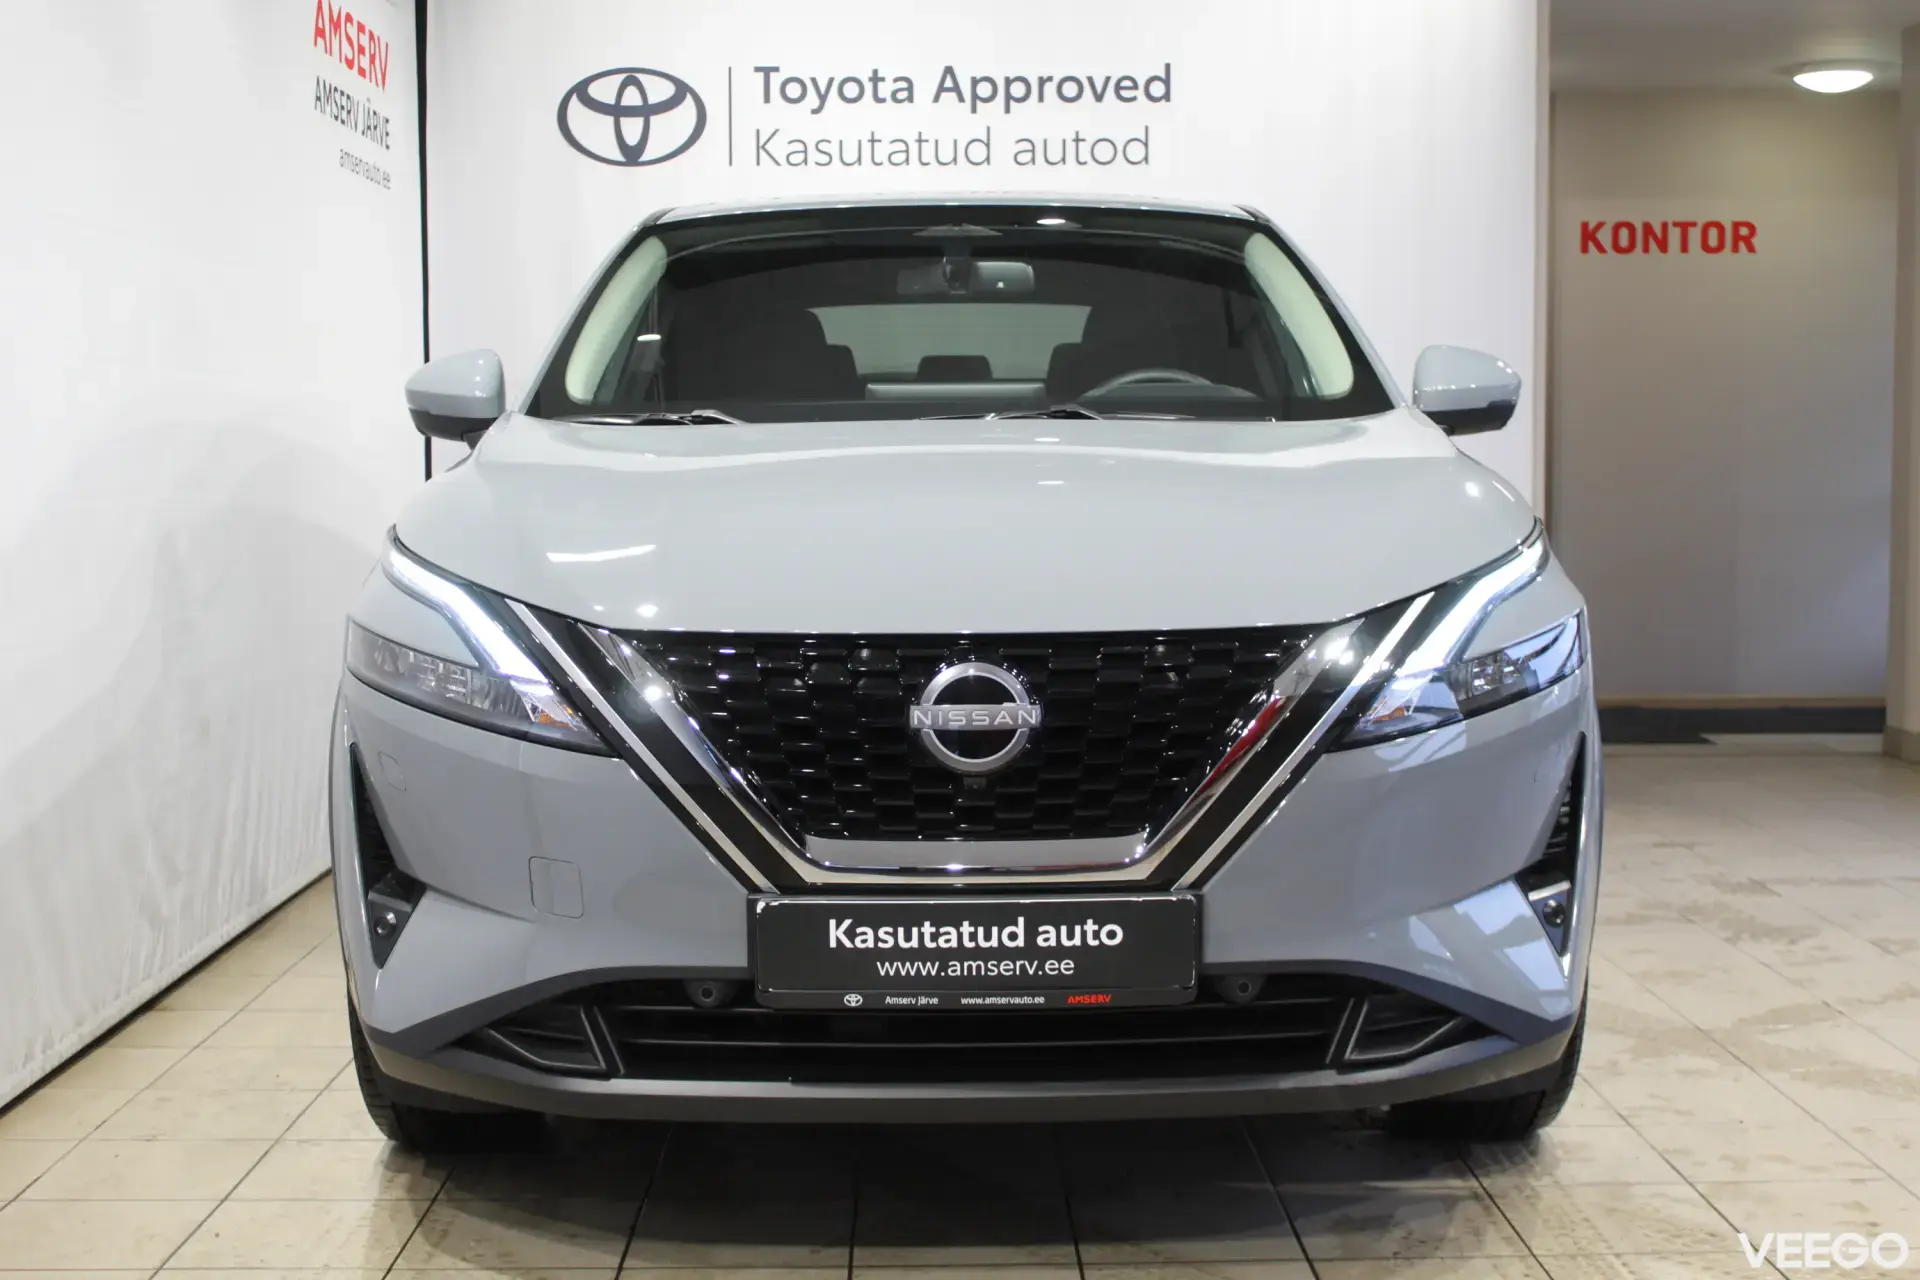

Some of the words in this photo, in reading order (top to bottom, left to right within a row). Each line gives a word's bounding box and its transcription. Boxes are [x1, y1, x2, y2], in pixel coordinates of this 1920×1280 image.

[313, 0, 389, 92] AMSERV
[754, 65, 915, 114] Toyota
[932, 63, 1172, 114] Approved
[314, 75, 359, 133] AMSERV
[361, 96, 390, 150] JÄRVE
[755, 125, 991, 166] Kasutatud
[1013, 125, 1150, 166] autod
[339, 148, 391, 190] amservauto.ee
[1580, 220, 1757, 255] KONTOR
[913, 709, 1036, 726] NISSAN
[828, 917, 1025, 949] Kasutatud
[1036, 919, 1124, 947] auto
[876, 957, 1075, 977] www.amserv.ee
[885, 995, 917, 1005] Amserv
[918, 995, 939, 1006] Järve
[960, 995, 1045, 1005] www.amservauto.ee
[1067, 994, 1112, 1005] AMSERV
